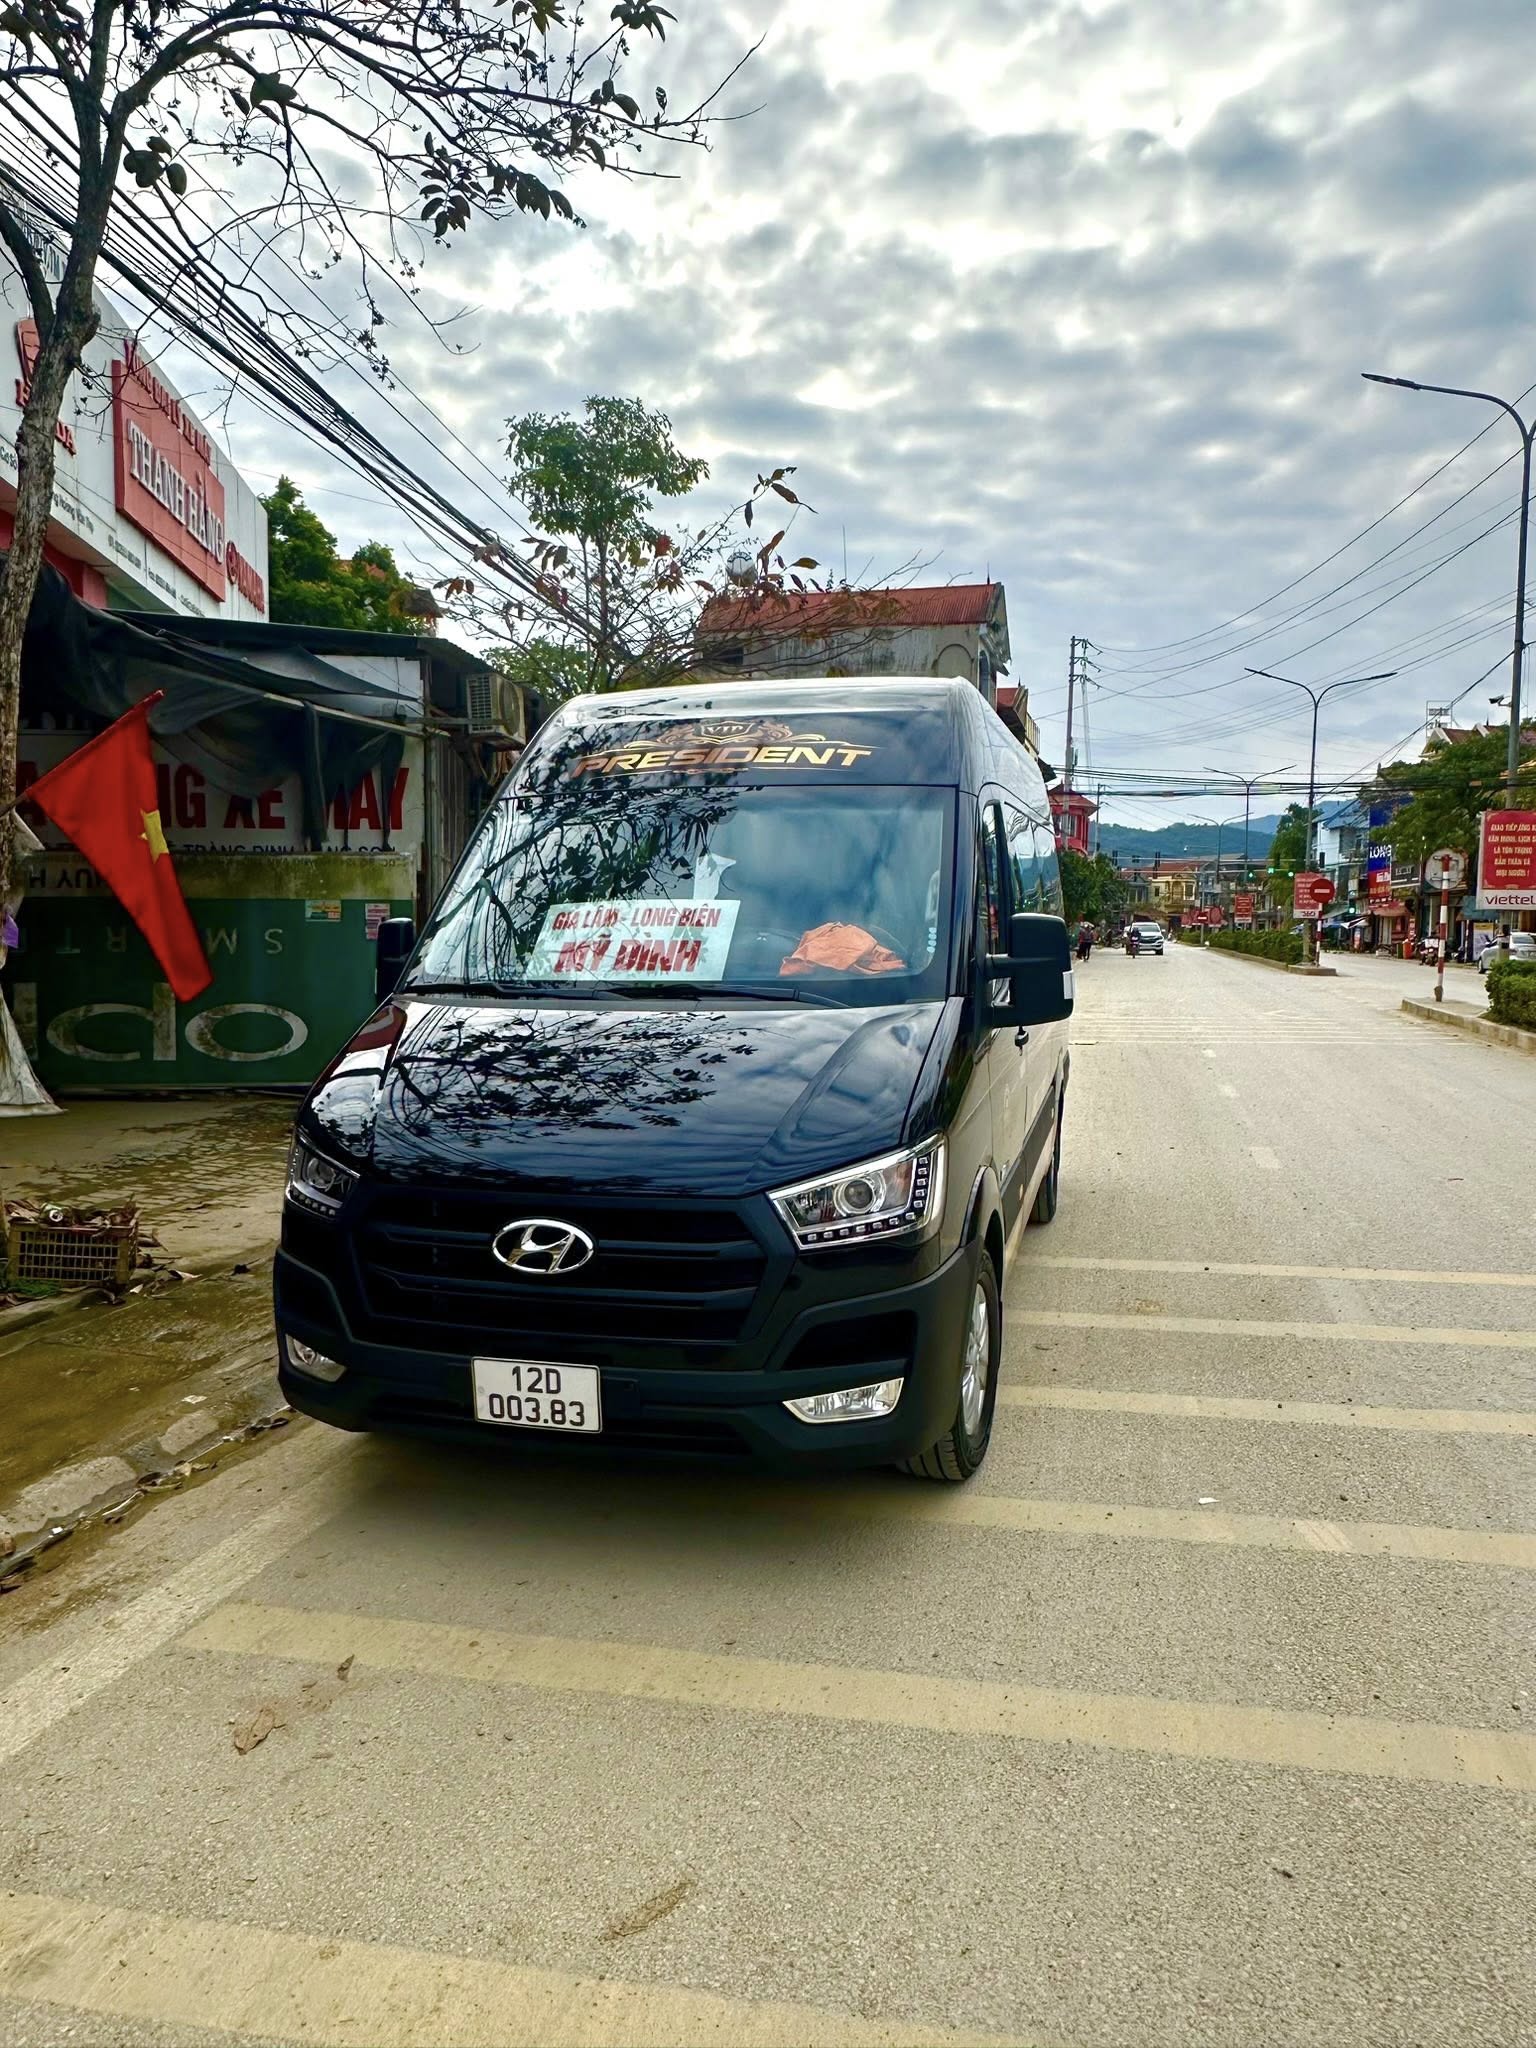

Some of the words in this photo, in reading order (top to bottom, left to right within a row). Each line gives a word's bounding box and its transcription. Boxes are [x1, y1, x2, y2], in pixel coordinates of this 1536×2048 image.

[128, 423, 187, 524] THANH
[571, 746, 872, 778] PRESIDENT
[1485, 895, 1536, 905] viettel
[552, 911, 580, 931] GIA
[582, 905, 619, 929] LÂM
[631, 907, 677, 928] LONG
[677, 903, 722, 928] BIÊN
[554, 933, 612, 973] MỸ
[614, 931, 702, 973] ĐÌNH
[510, 1365, 561, 1395] 12D
[488, 1393, 586, 1427] 003.83
